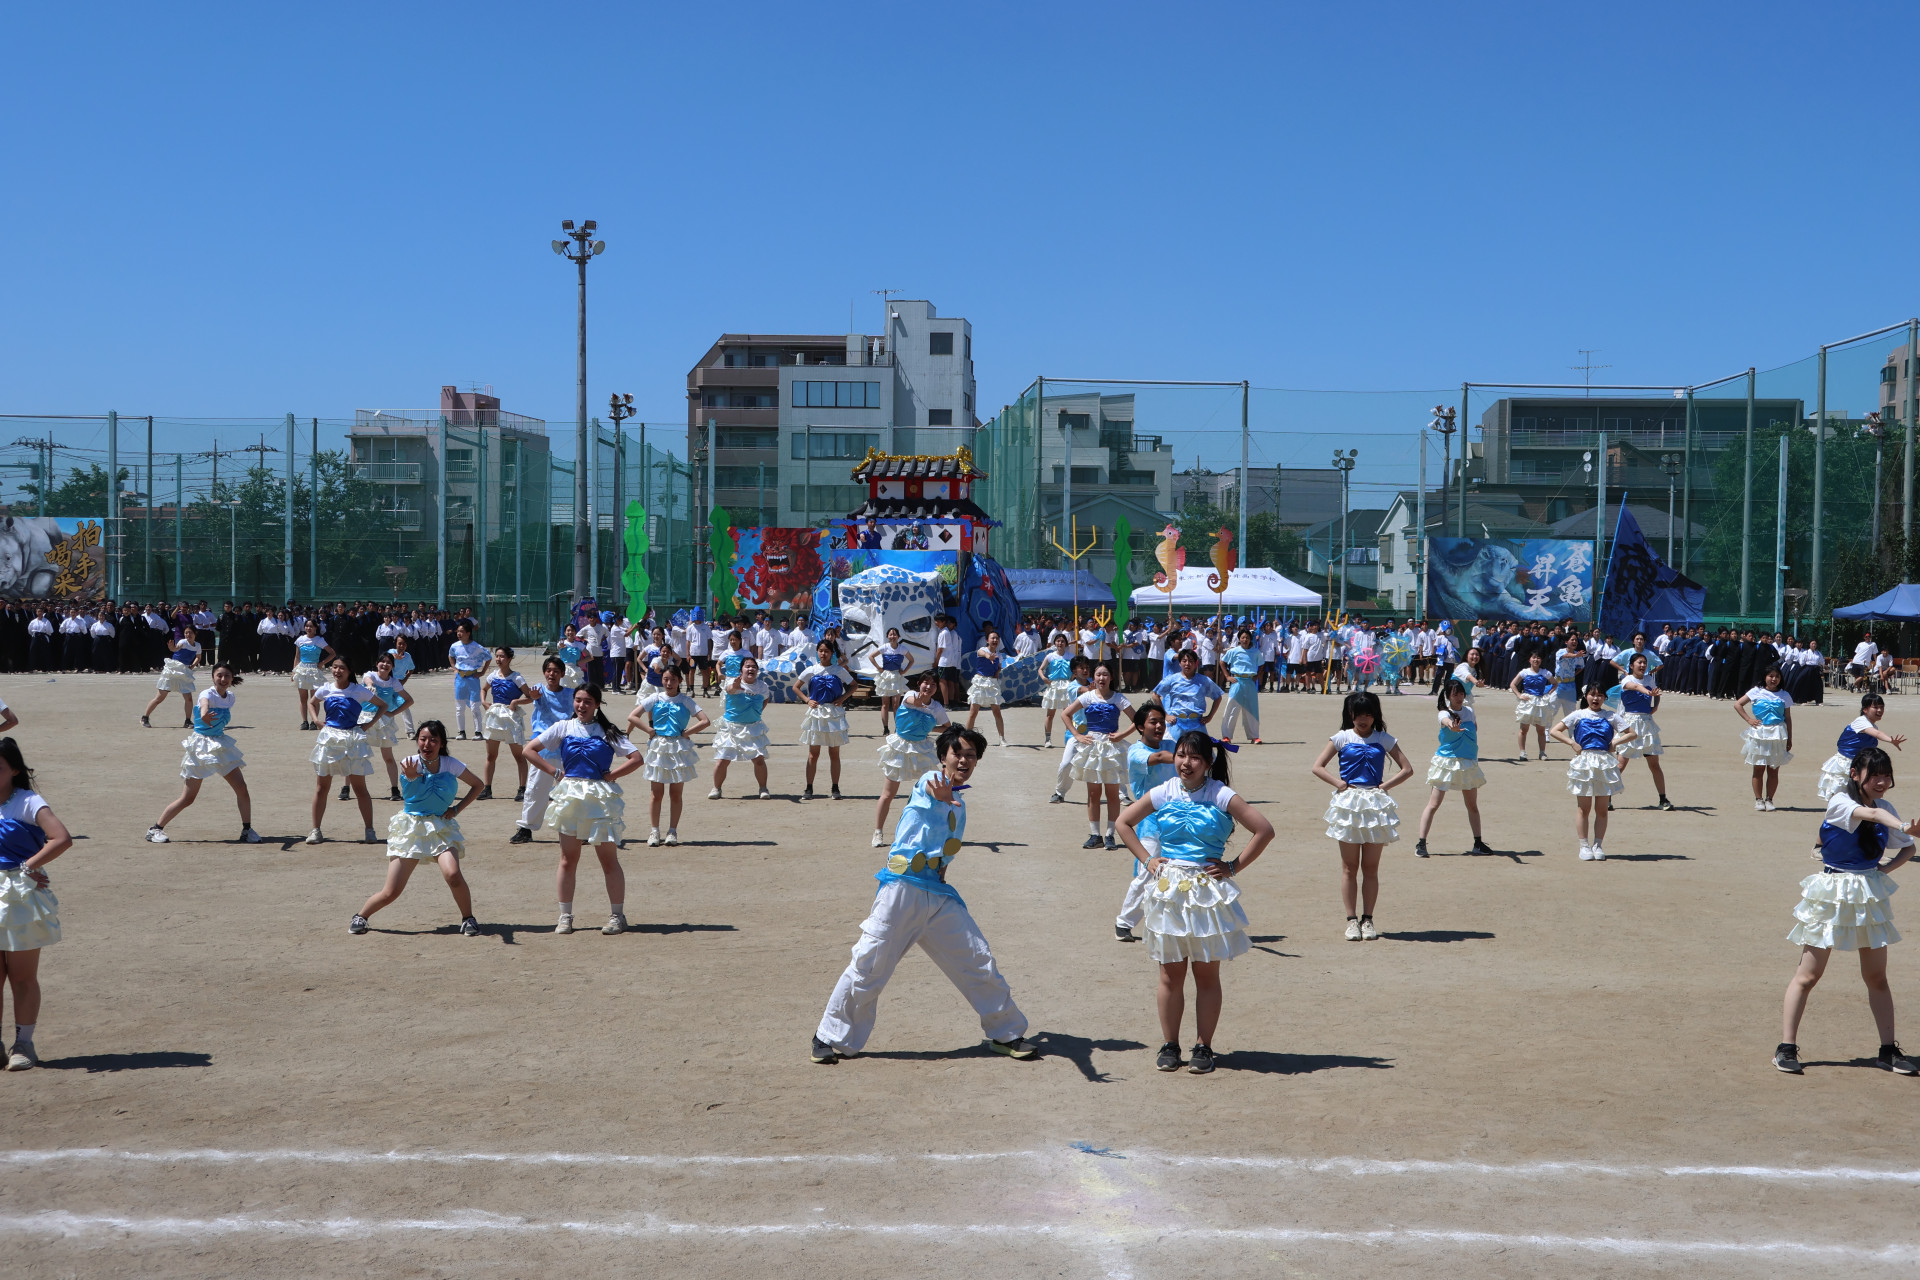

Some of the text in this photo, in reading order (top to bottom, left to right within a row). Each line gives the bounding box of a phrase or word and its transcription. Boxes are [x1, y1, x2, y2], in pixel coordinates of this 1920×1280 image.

[71, 519, 102, 579] 拍手
[1557, 541, 1593, 607] 蒼亀
[1522, 552, 1558, 617] 昇天
